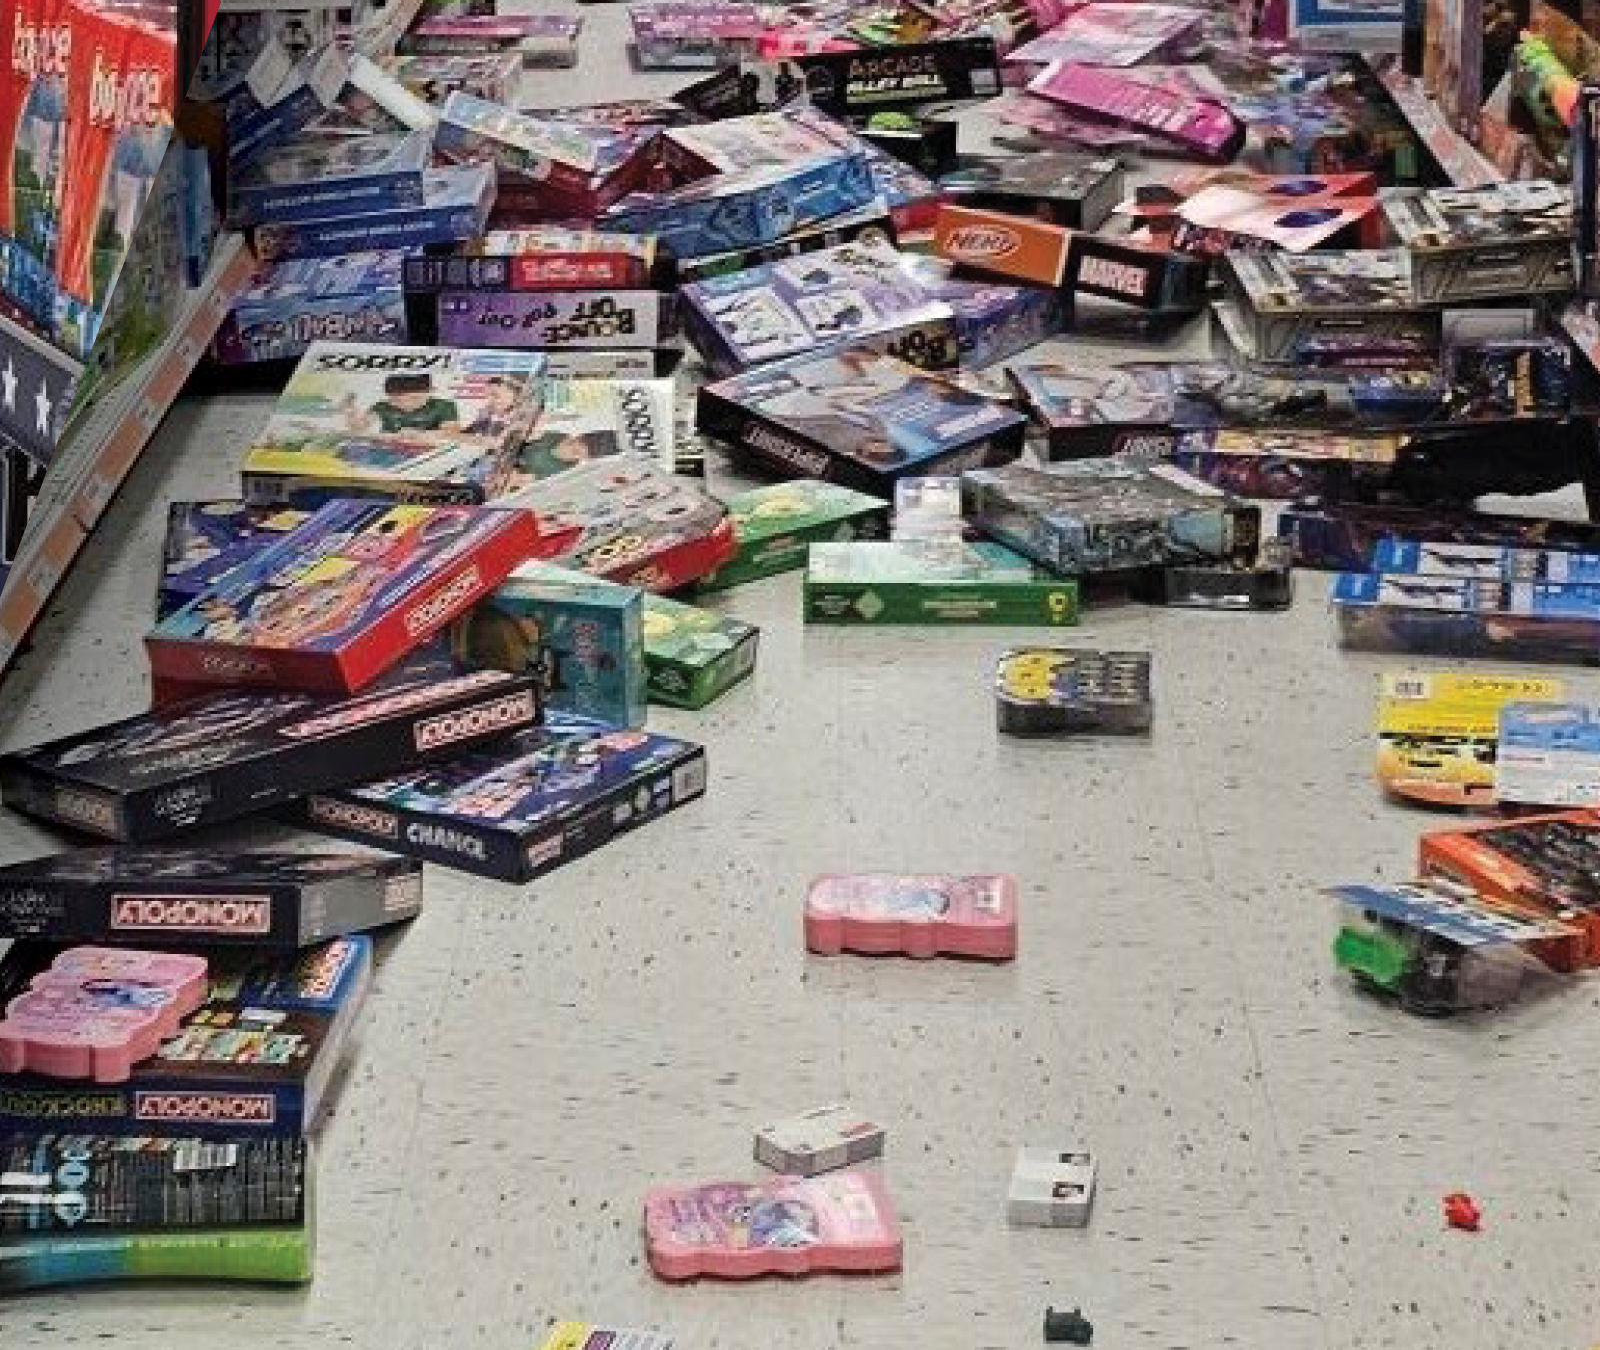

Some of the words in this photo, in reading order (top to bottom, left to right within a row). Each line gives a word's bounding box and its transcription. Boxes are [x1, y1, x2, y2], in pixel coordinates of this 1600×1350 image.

[11, 6, 71, 80] bounce
[850, 55, 936, 77] ARCADE
[88, 46, 161, 129] bounce
[317, 353, 451, 371] SORRY!
[417, 692, 533, 747] MONOPOLY
[310, 798, 398, 840] MONOPOLY
[115, 898, 267, 927] MONOPOLY
[139, 1095, 271, 1117] MONOPOLY
